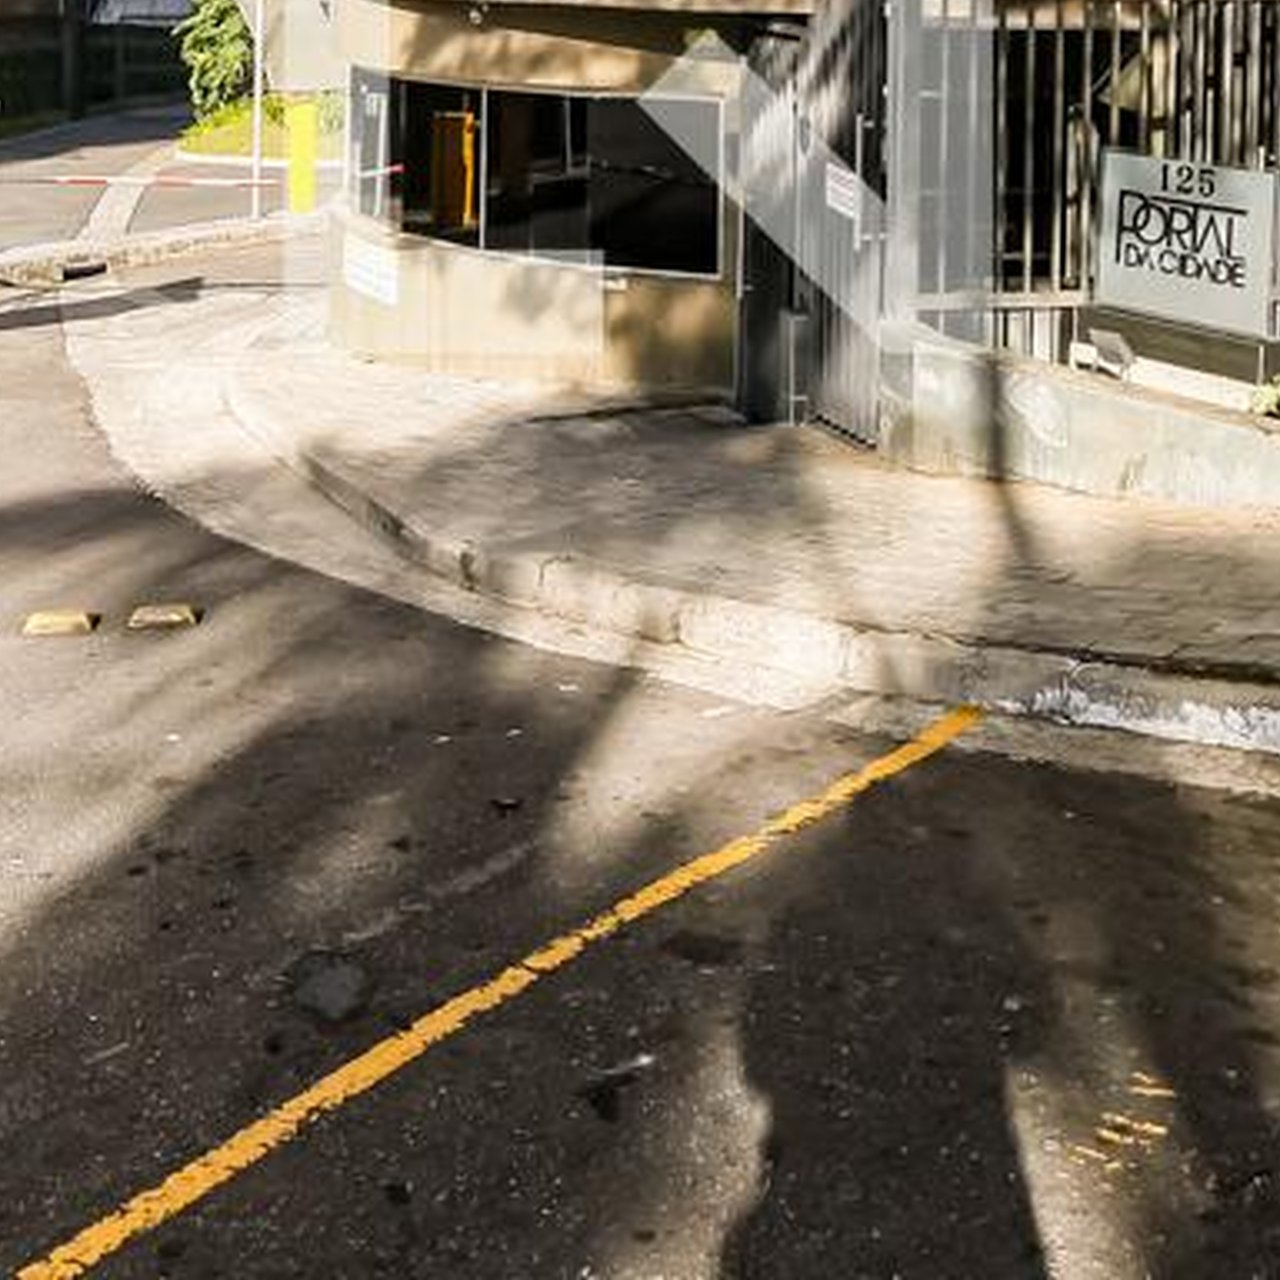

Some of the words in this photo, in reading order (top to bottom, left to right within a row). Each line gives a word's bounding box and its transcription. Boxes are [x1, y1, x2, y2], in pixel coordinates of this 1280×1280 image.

[1161, 164, 1216, 197] 125
[1116, 189, 1248, 263] PORTAL
[1124, 243, 1154, 272] DA
[1158, 250, 1246, 288] CIDADE
